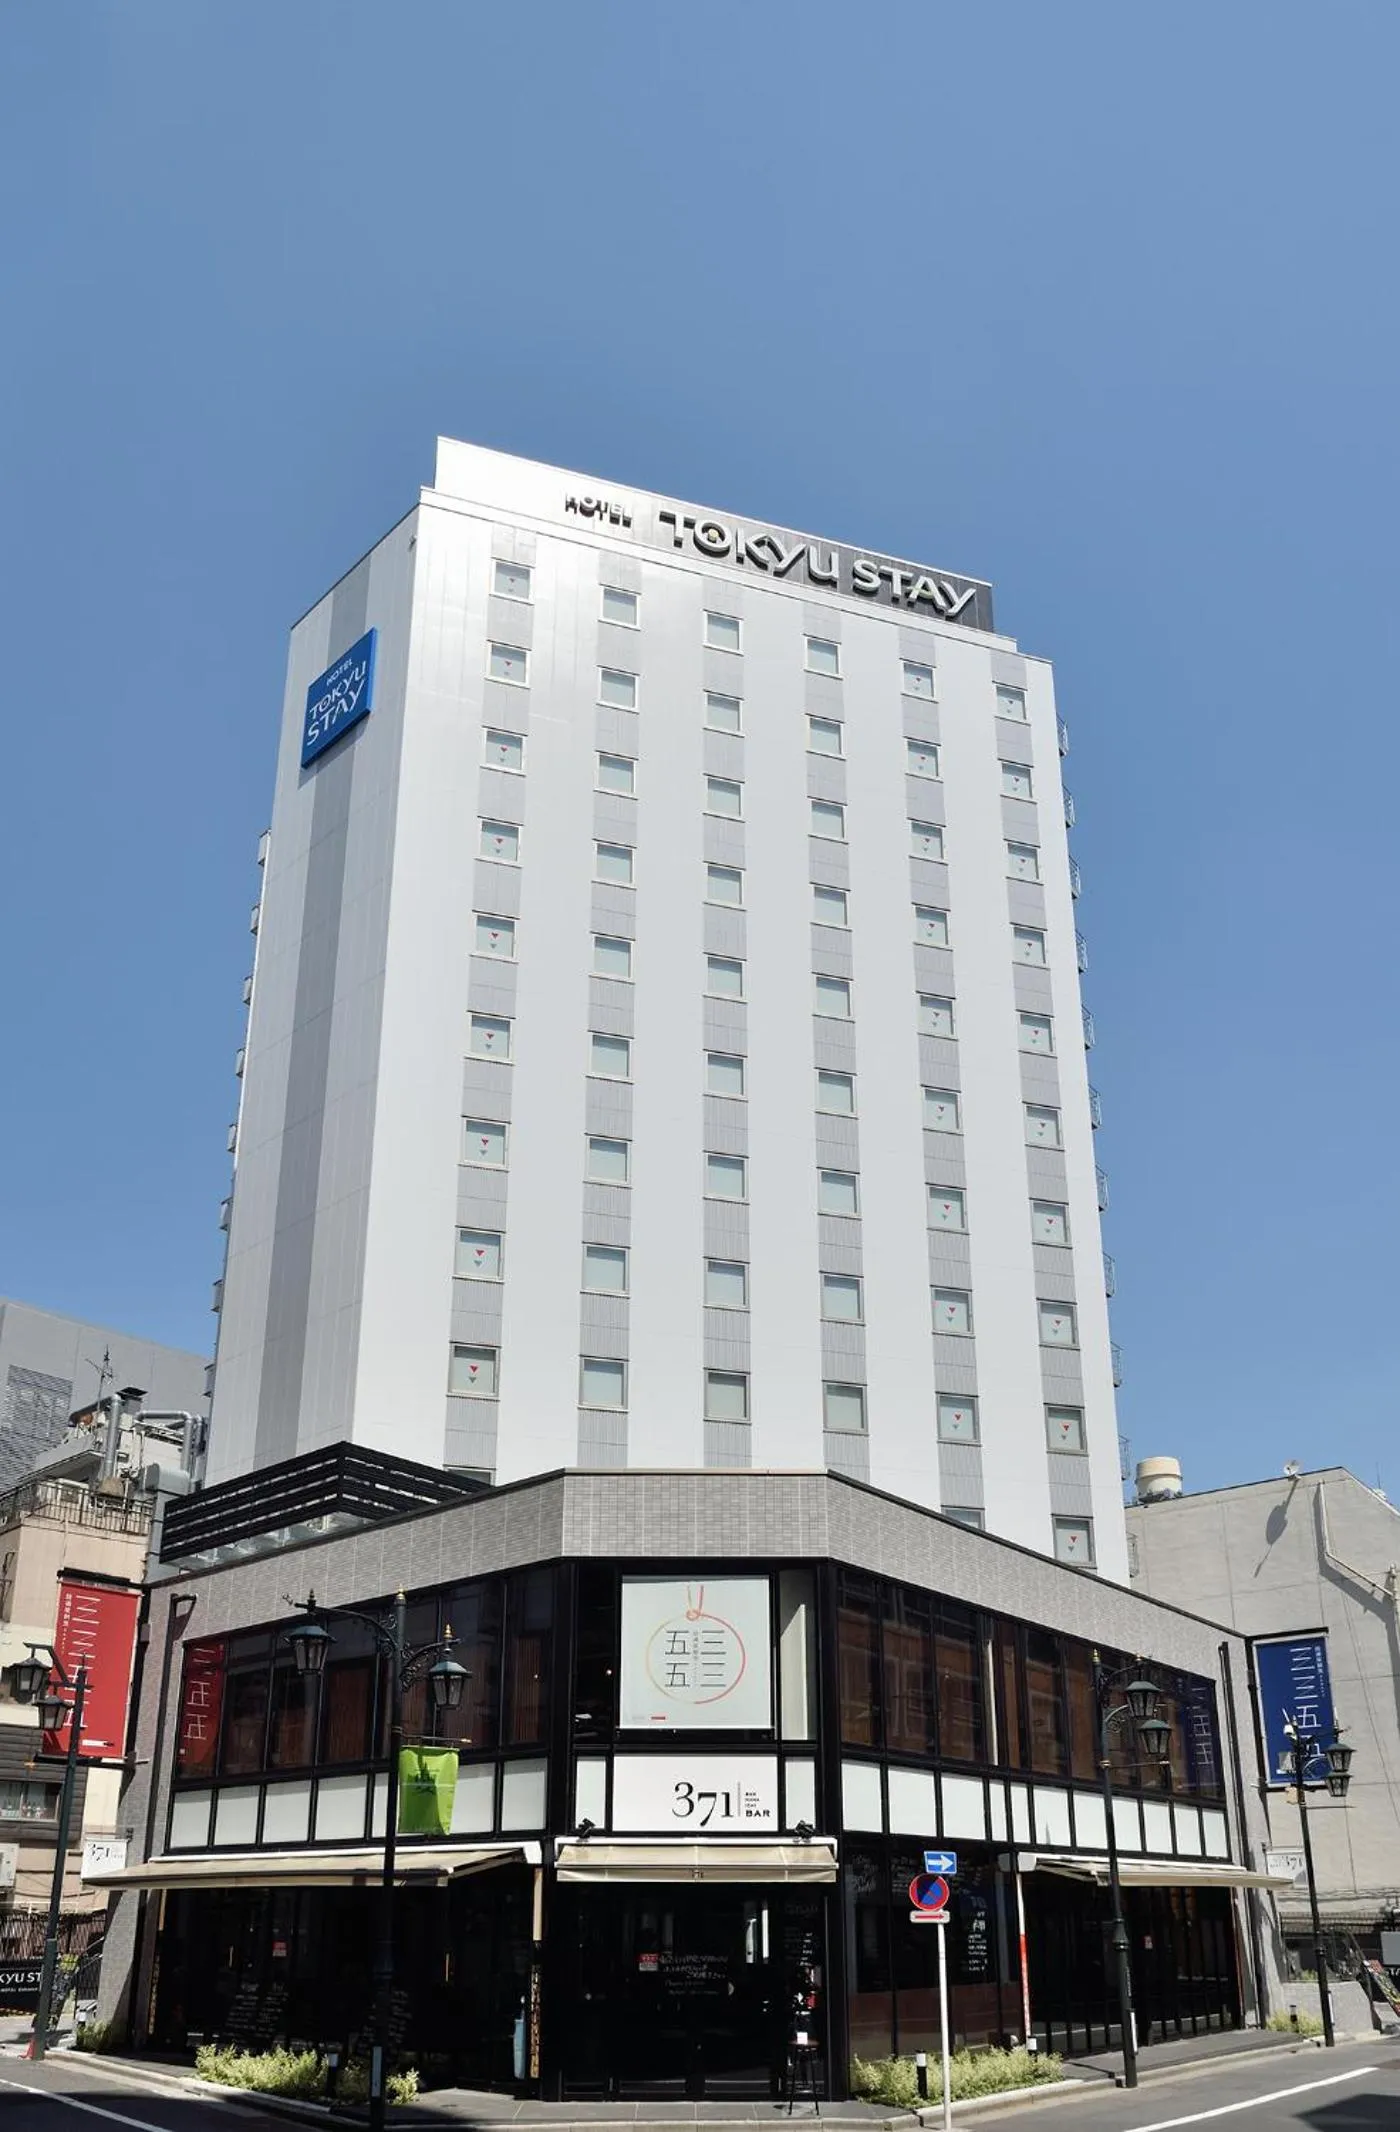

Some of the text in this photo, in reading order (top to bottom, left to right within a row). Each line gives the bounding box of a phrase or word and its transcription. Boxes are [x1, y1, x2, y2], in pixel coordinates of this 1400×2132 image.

[564, 489, 977, 620] HOTEL TOKYU STAY
[306, 679, 365, 747] STAY
[309, 660, 367, 720] TOKYU
[671, 1781, 734, 1827] 371
[745, 1809, 771, 1818] BAR
